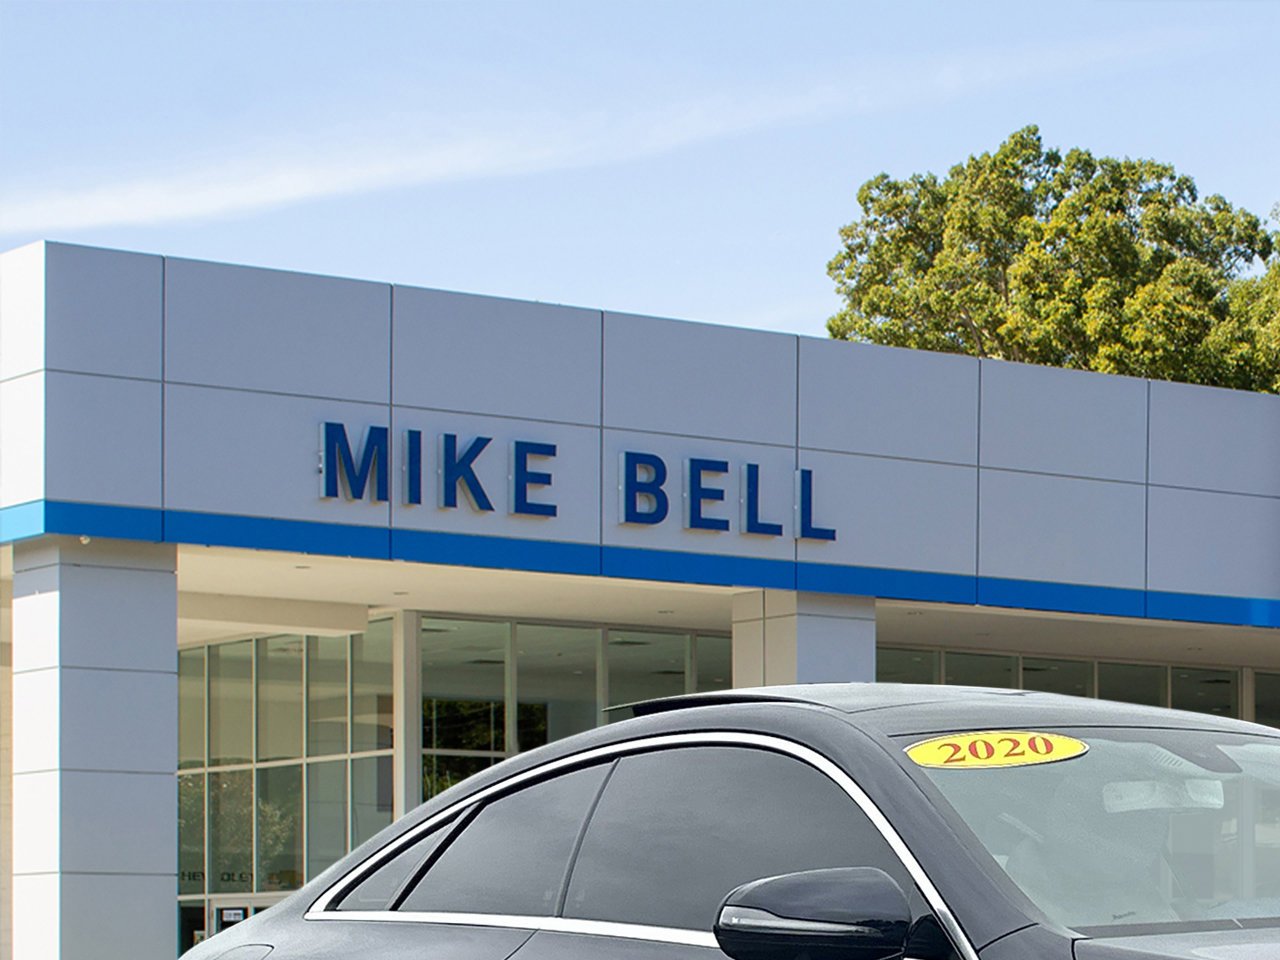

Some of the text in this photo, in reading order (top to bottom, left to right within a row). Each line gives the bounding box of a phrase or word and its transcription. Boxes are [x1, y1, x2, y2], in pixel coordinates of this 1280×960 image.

[321, 421, 837, 542] MIKE BELL
[937, 736, 1054, 764] 2020
